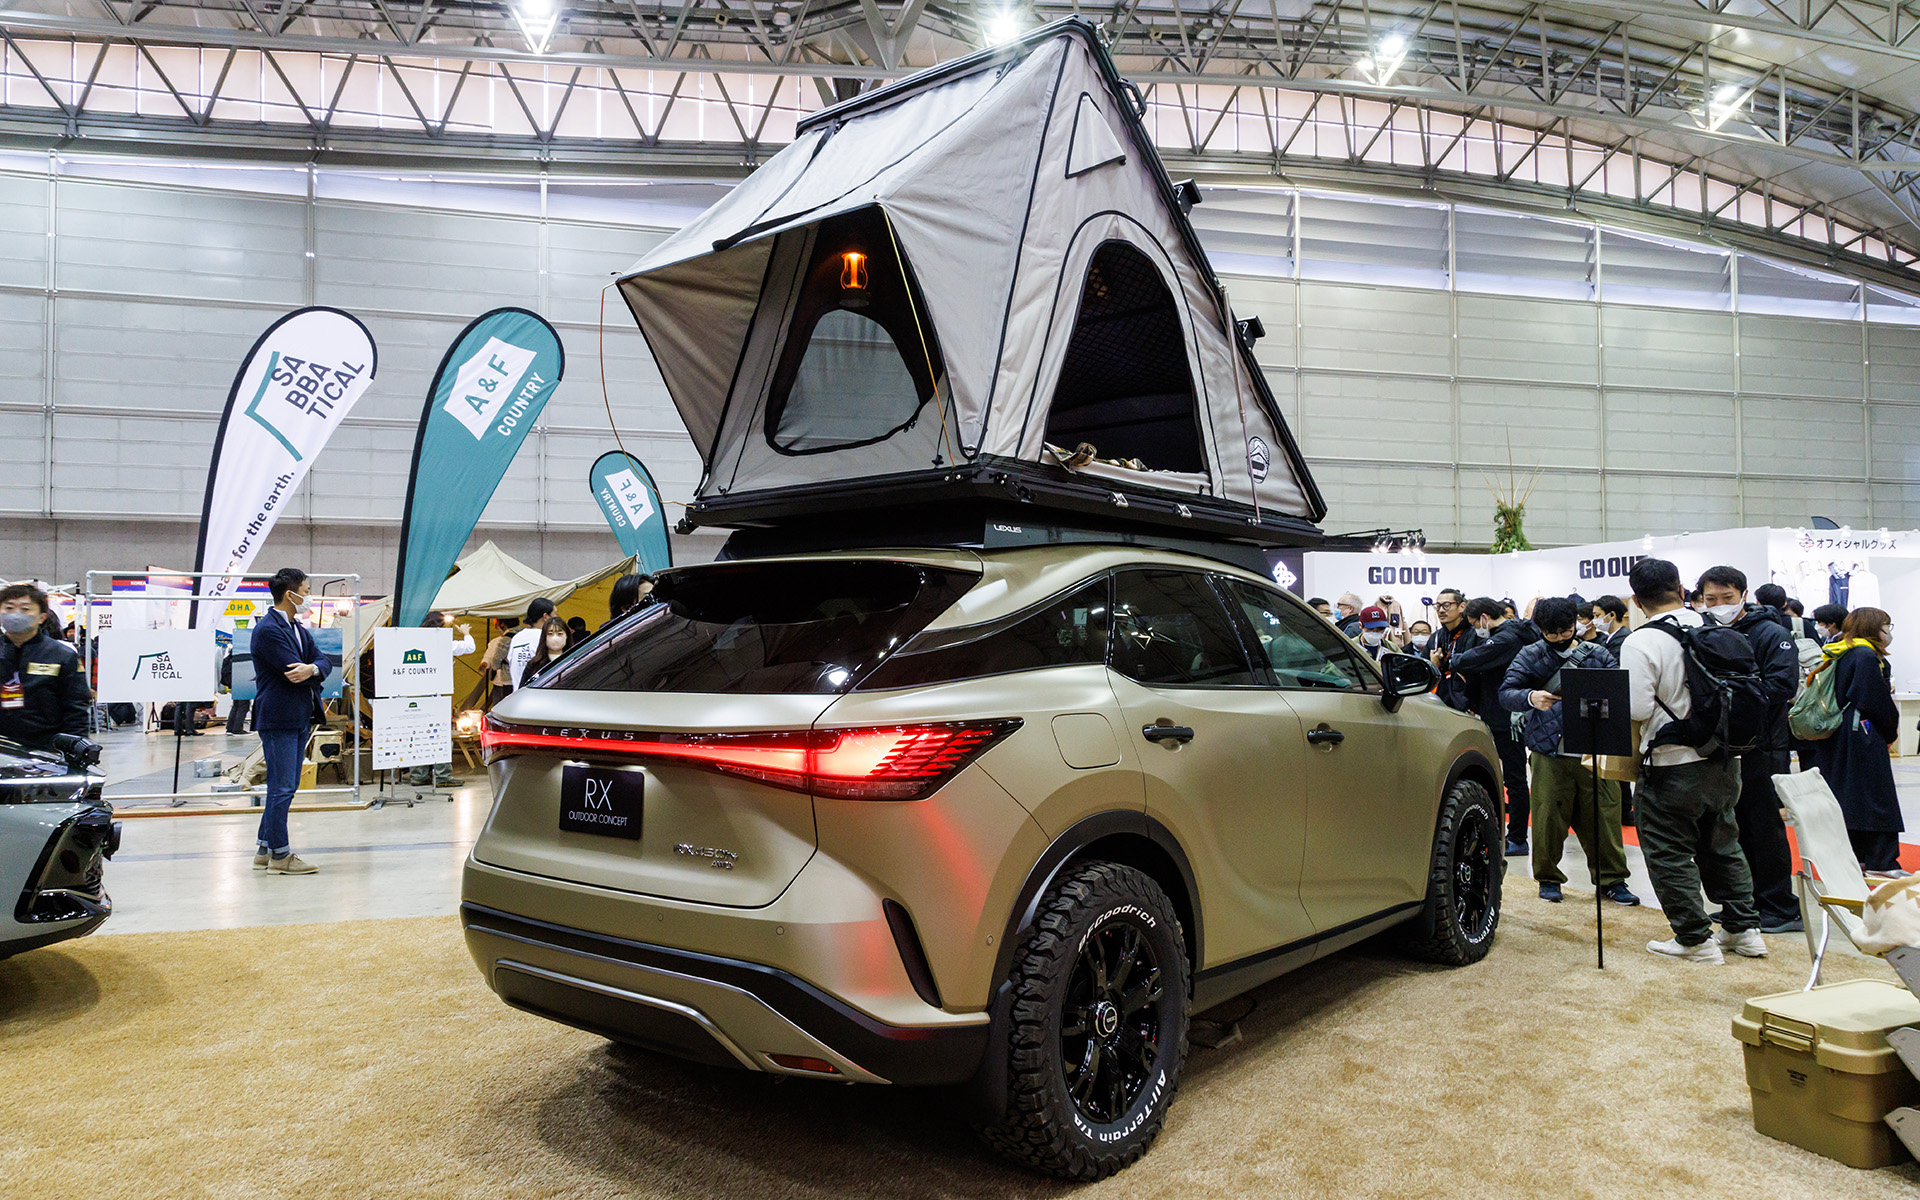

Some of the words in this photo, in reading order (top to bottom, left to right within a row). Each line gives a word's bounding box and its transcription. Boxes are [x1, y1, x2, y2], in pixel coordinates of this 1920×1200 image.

[271, 355, 306, 387] SA
[285, 362, 332, 410] BBA
[306, 361, 365, 419] TICAL
[497, 372, 545, 436] COUNTRY
[231, 536, 251, 559] for
[246, 512, 267, 536] the
[263, 471, 295, 512] earth.
[993, 523, 1023, 534] LEXUS
[1368, 566, 1396, 585] GO
[1399, 567, 1440, 585] OUT
[1579, 558, 1605, 579] GO
[151, 663, 174, 671] BBA
[151, 671, 182, 679] TICAL
[408, 667, 437, 675] COUNTRY
[541, 727, 635, 741] LEXUS
[584, 778, 613, 811] RX
[568, 810, 598, 823] OUTDOOR
[598, 813, 628, 826] CONCEPT
[1099, 1068, 1166, 1144] All-Terrain
